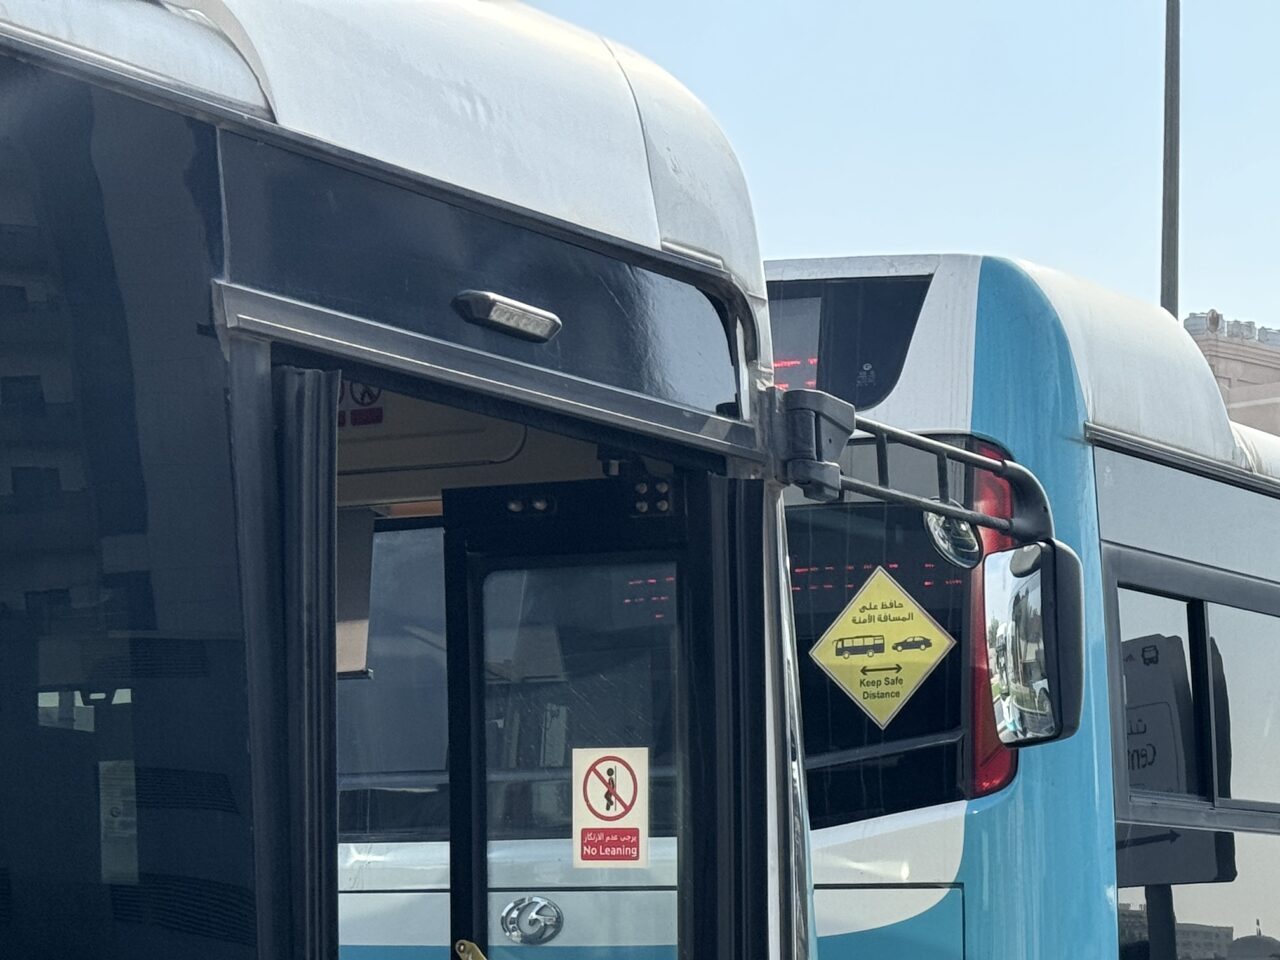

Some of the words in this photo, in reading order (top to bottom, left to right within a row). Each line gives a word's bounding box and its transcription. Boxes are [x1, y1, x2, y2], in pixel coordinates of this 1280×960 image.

[859, 601, 878, 613] على
[881, 600, 904, 610] حافظ
[877, 613, 914, 623] المسافة
[859, 678, 882, 688] Keep
[884, 676, 904, 686] Safe
[862, 690, 900, 700] Distance
[583, 846, 598, 855] No
[599, 845, 637, 857] Leaning
